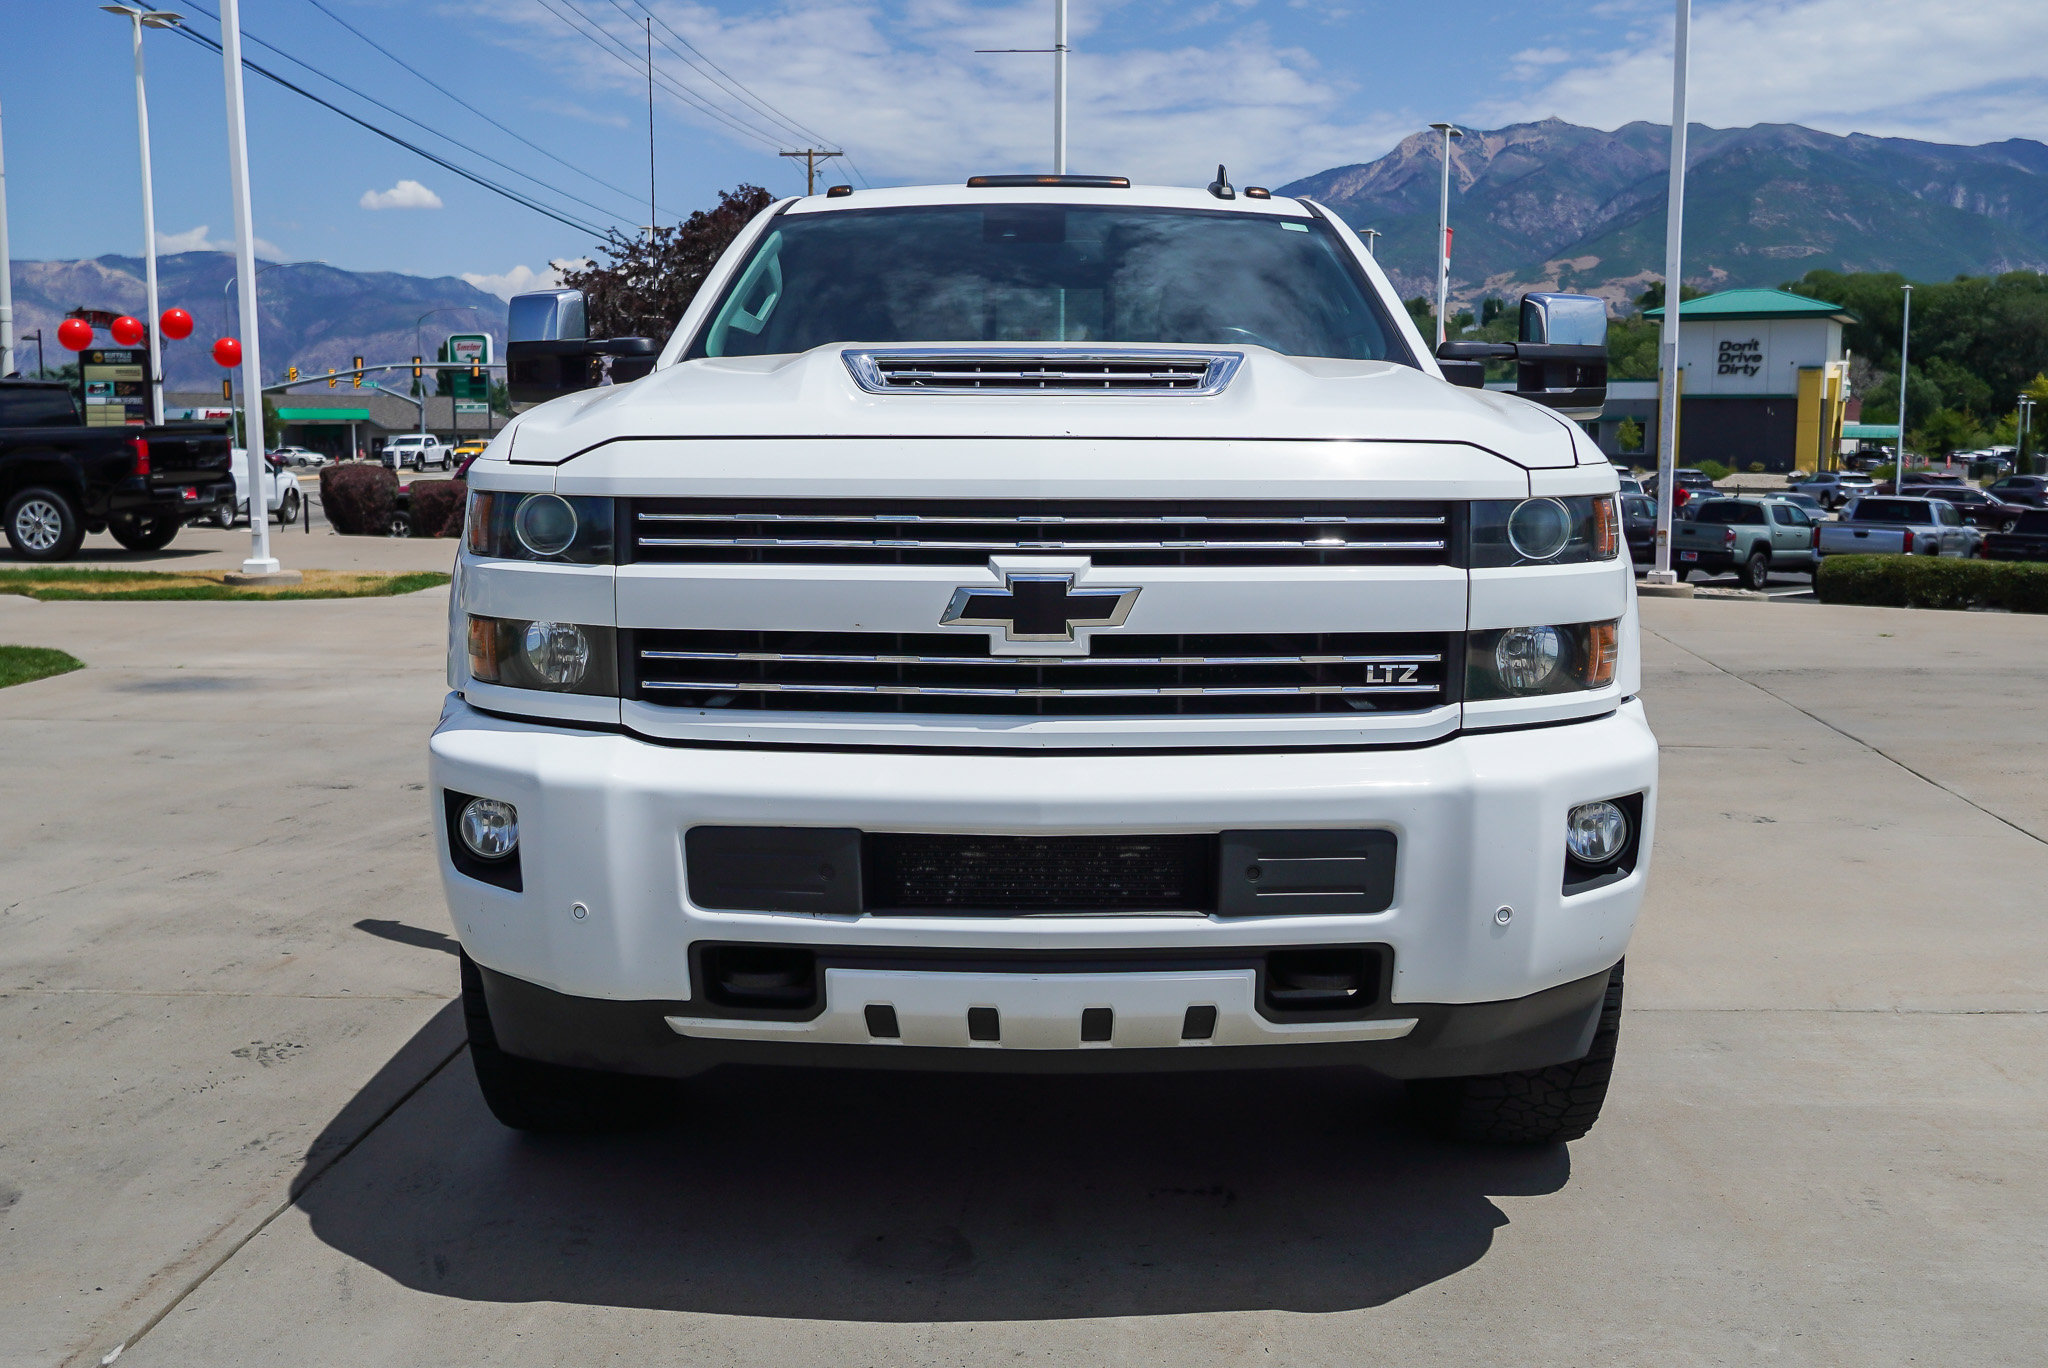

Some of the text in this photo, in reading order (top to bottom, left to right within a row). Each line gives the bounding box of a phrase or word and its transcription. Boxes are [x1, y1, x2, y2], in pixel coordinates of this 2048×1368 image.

[1719, 339, 1759, 351] Don't
[1718, 352, 1762, 363] Drive
[1718, 363, 1760, 377] Dirty
[1366, 664, 1419, 683] LTZ
